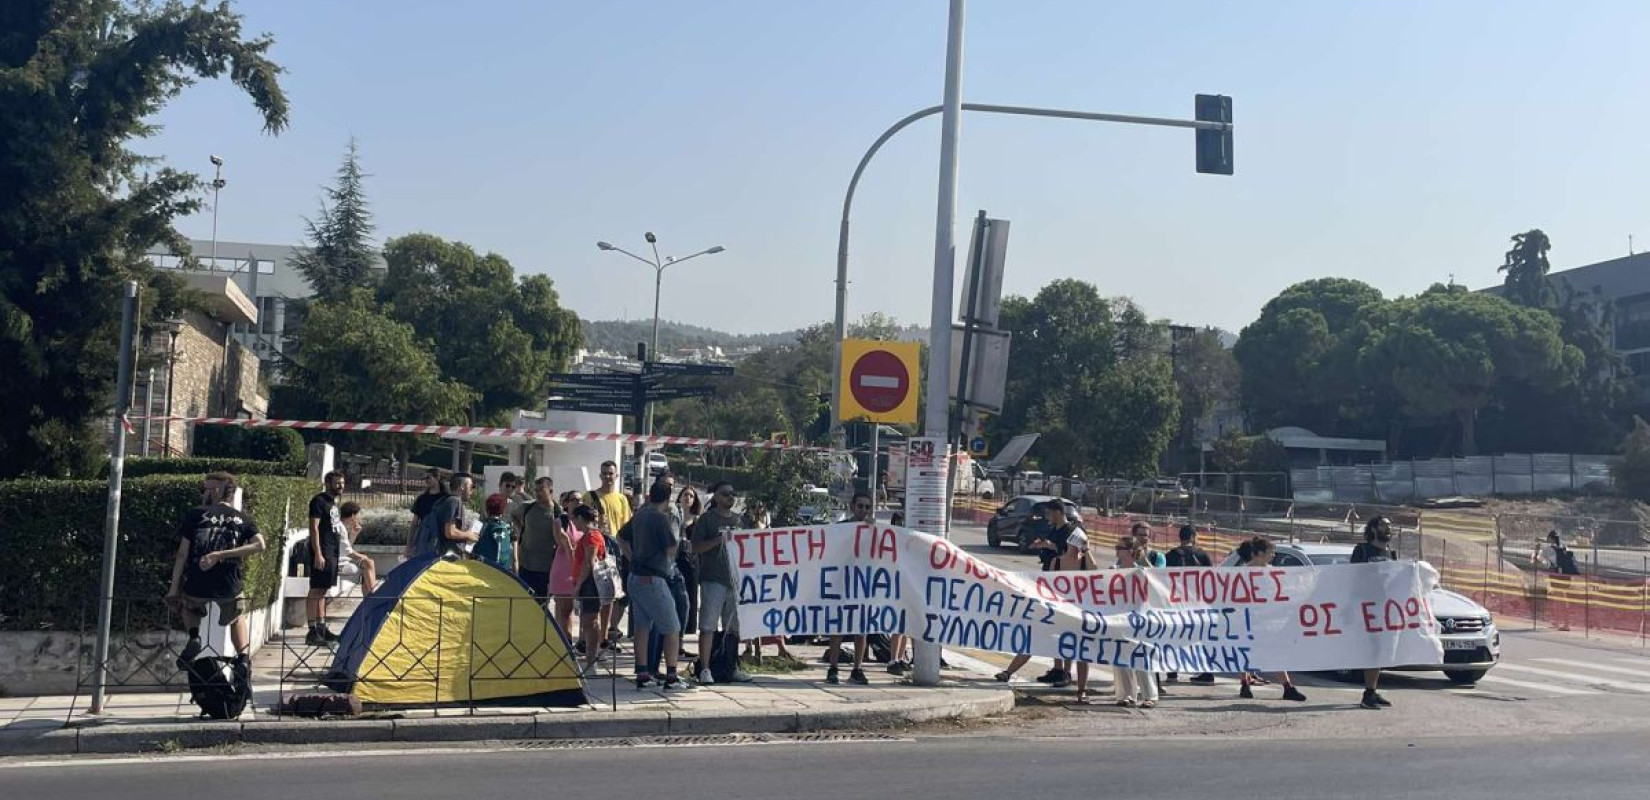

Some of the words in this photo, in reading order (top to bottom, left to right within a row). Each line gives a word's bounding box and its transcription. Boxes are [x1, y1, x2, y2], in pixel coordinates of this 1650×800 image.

[734, 529, 826, 569] ΣΤΕΓΗ
[854, 525, 898, 563] ΓΙΑ
[1036, 573, 1149, 605] ΔΩΡΕΑΝ
[1169, 570, 1290, 603] ΣΠΟΥΔΕΣ
[739, 570, 799, 605] ΔΕΝ
[820, 566, 900, 600] ΕΙΝΑΙ
[925, 576, 1056, 625] ΠΕΛΑΤΕΣ
[1082, 609, 1106, 635] ΟΙ
[1300, 603, 1342, 637] ΩΣ
[1363, 597, 1433, 632] ΕΔΩ!
[763, 604, 906, 636] ΦΟΙΤΗΤΙΚΟΙ
[923, 613, 1032, 654] ΣΥΛΛΟΓΟΙ
[1058, 631, 1261, 673] ΘΕΣΣΑΛΟΝΙΚΗΣ
